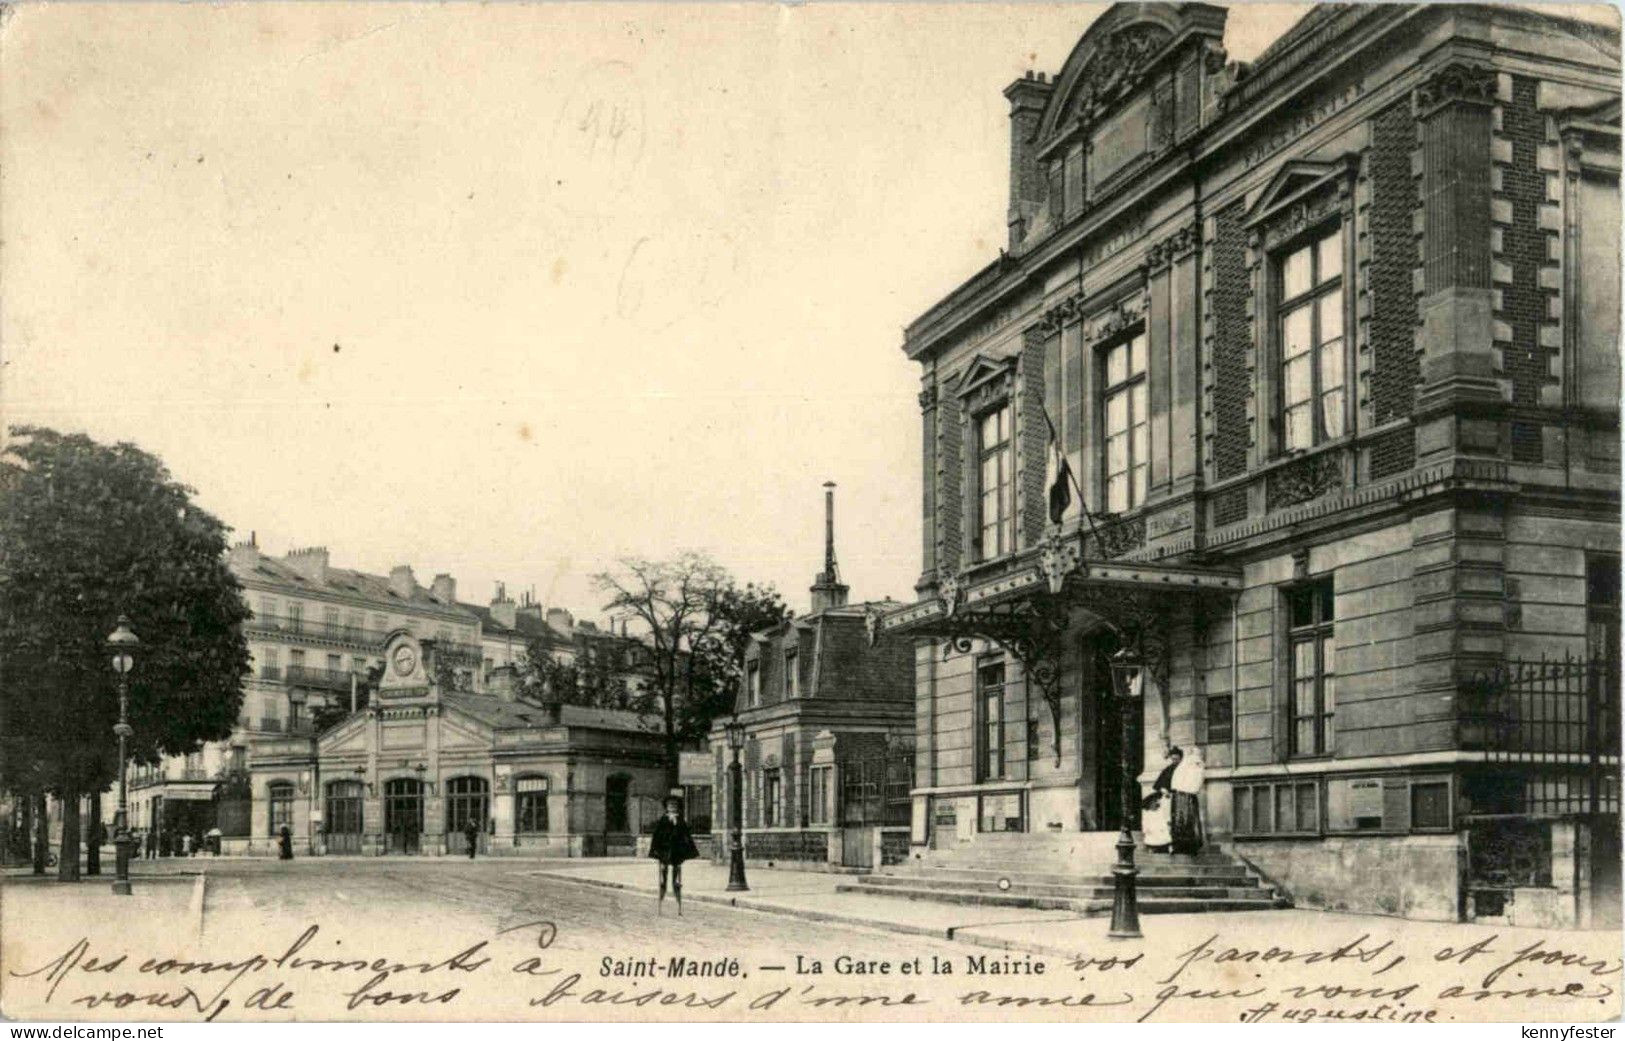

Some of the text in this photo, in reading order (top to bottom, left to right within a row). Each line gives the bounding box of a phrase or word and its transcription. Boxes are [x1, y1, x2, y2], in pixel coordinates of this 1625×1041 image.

[9, 937, 128, 1003] Mes
[139, 924, 491, 1012] compliments
[1435, 934, 1499, 965] et
[1483, 940, 1623, 988] pour
[599, 956, 748, 979] Saint-Mandé.
[796, 955, 823, 975] La
[834, 955, 892, 975] Gare
[901, 956, 923, 975] et
[932, 955, 953, 975] la
[966, 955, 1046, 975] Mairie
[244, 982, 296, 1008] de
[342, 971, 460, 1010] bons
[529, 973, 737, 1010] baisers
[1137, 972, 1266, 1023] qui
[1281, 983, 1419, 1001] vous
